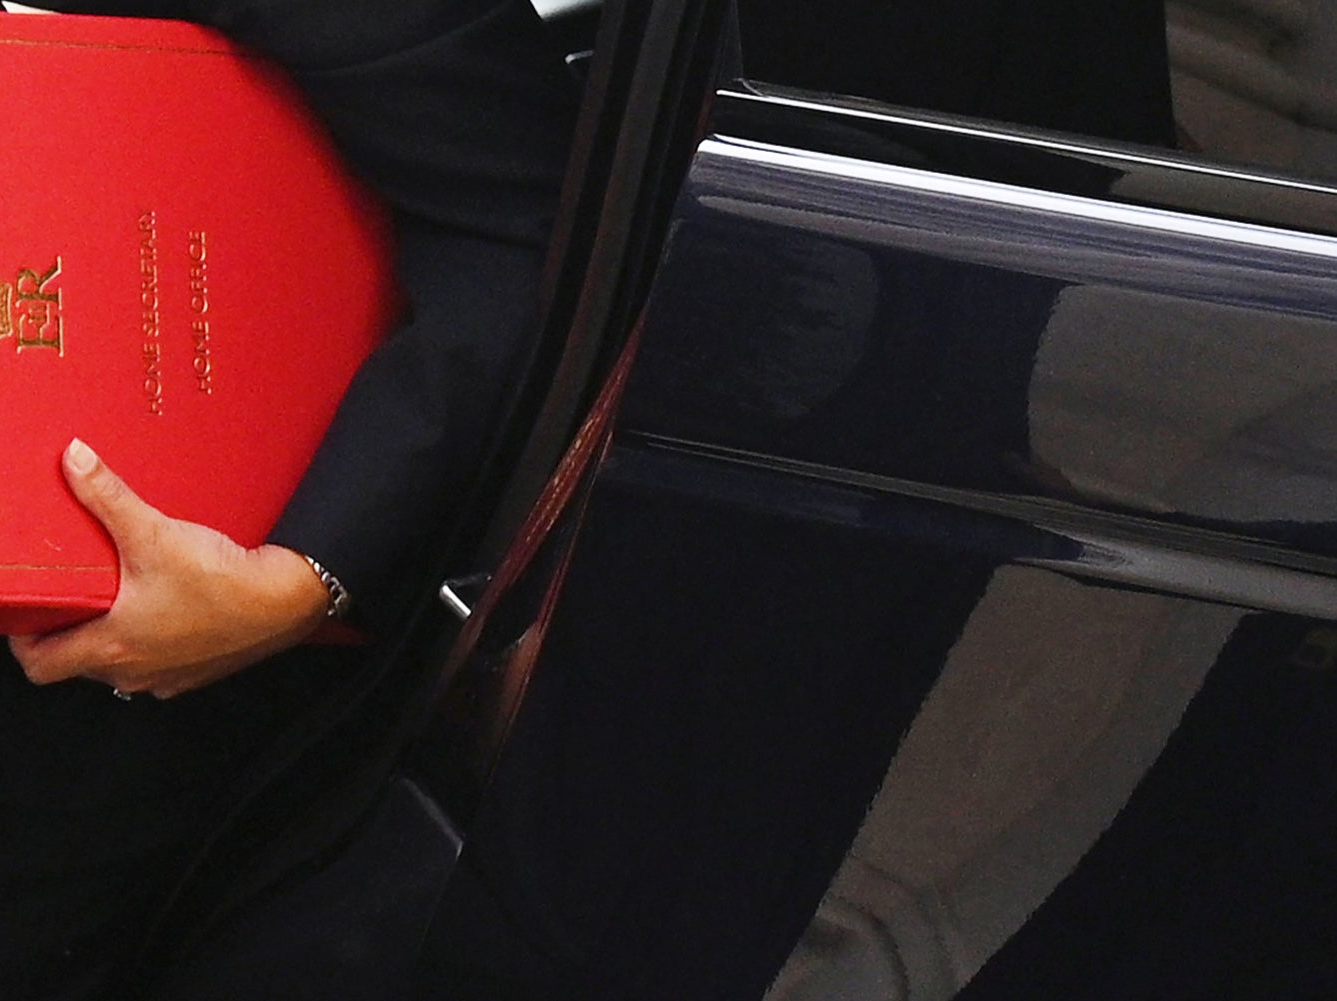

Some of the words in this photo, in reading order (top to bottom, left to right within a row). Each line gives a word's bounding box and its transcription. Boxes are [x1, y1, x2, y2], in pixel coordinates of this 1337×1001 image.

[138, 211, 160, 337] SECRETARY
[189, 231, 209, 314] OFFICE
[142, 343, 163, 416] HOME
[191, 321, 212, 394] HOME
